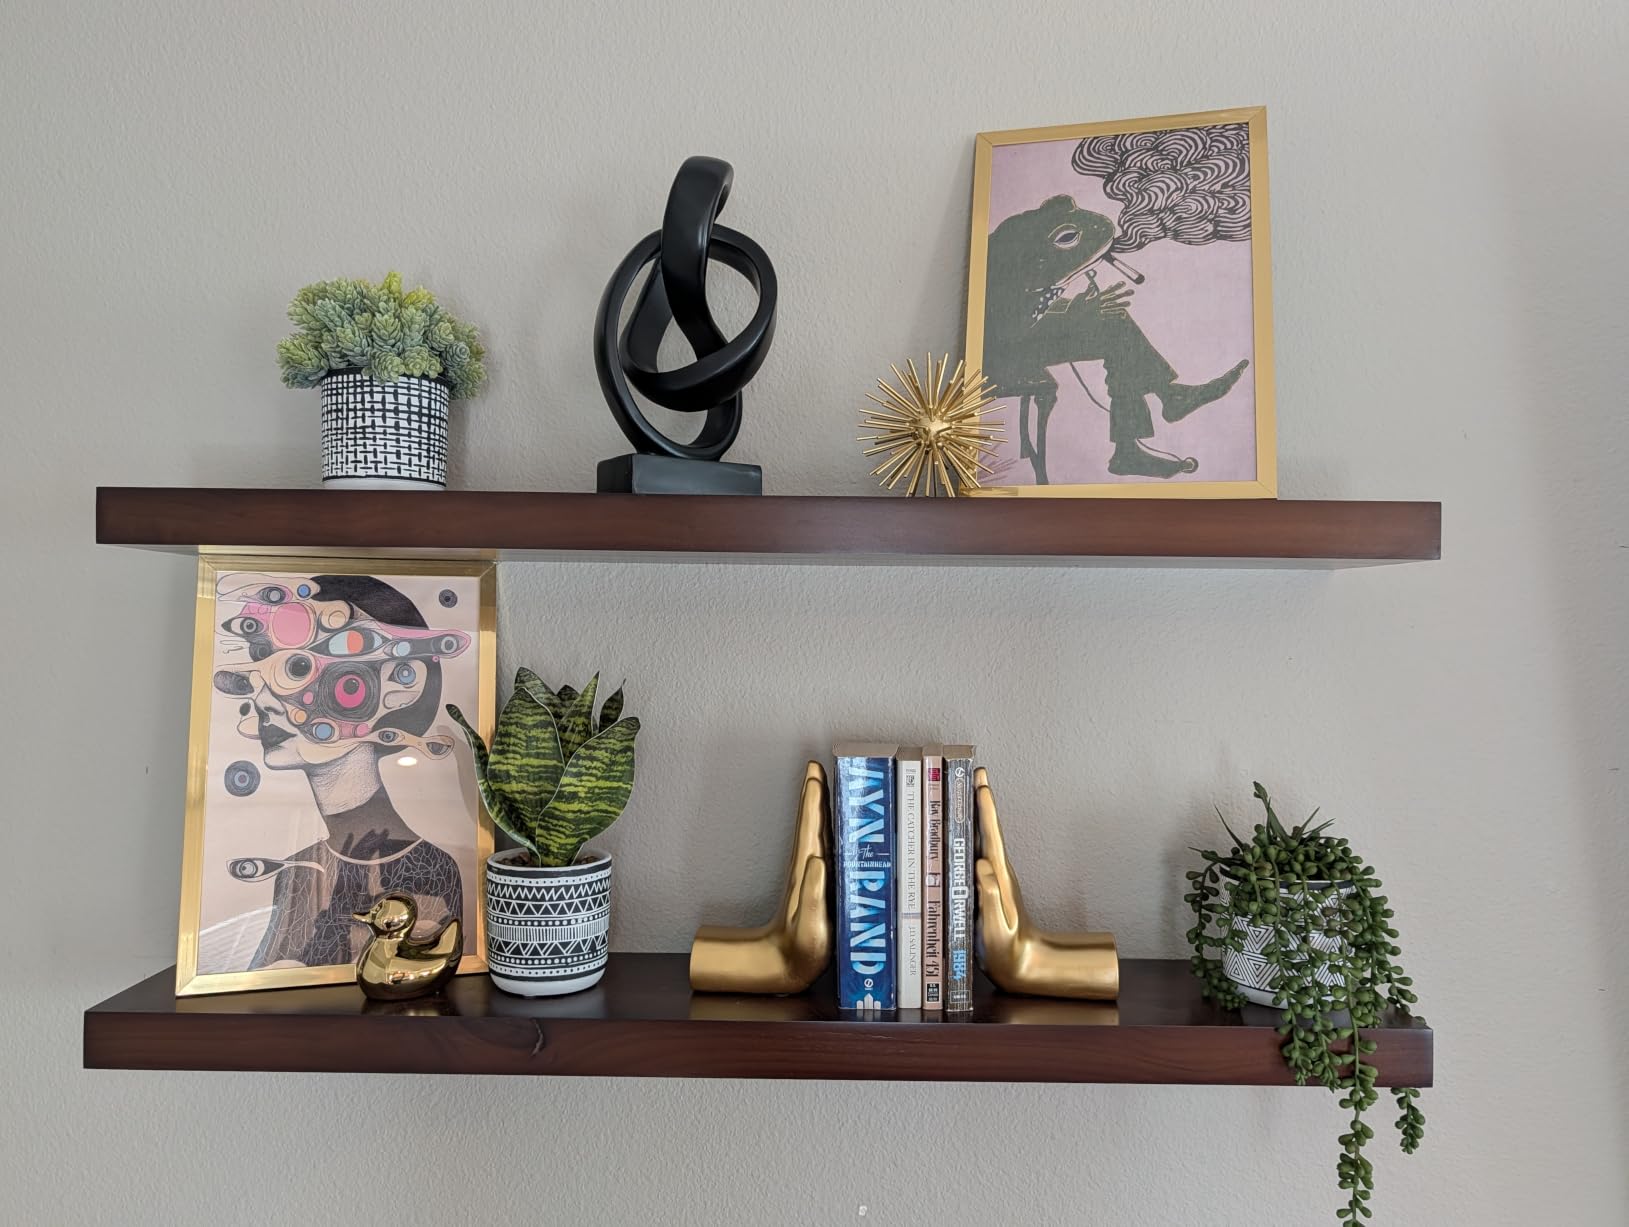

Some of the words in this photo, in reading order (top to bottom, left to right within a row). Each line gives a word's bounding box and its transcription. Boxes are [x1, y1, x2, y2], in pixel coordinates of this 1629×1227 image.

[848, 766, 885, 843] AYN
[906, 791, 915, 811] THE
[928, 800, 941, 816] Ray
[907, 812, 916, 855] CATCHER
[928, 819, 941, 860] Bradbury
[843, 860, 892, 868] FOUNTAINHEAD
[858, 844, 874, 859] The
[907, 857, 916, 868] IN
[953, 837, 966, 886] GEORGE
[907, 872, 916, 889] THE
[907, 892, 916, 911] RYE
[951, 886, 969, 942] ORWELL
[848, 870, 887, 975] RAND
[925, 900, 941, 958] Fahrenheit
[909, 938, 917, 976] SALINGER
[925, 961, 940, 977] 451
[951, 950, 967, 981] 1984
